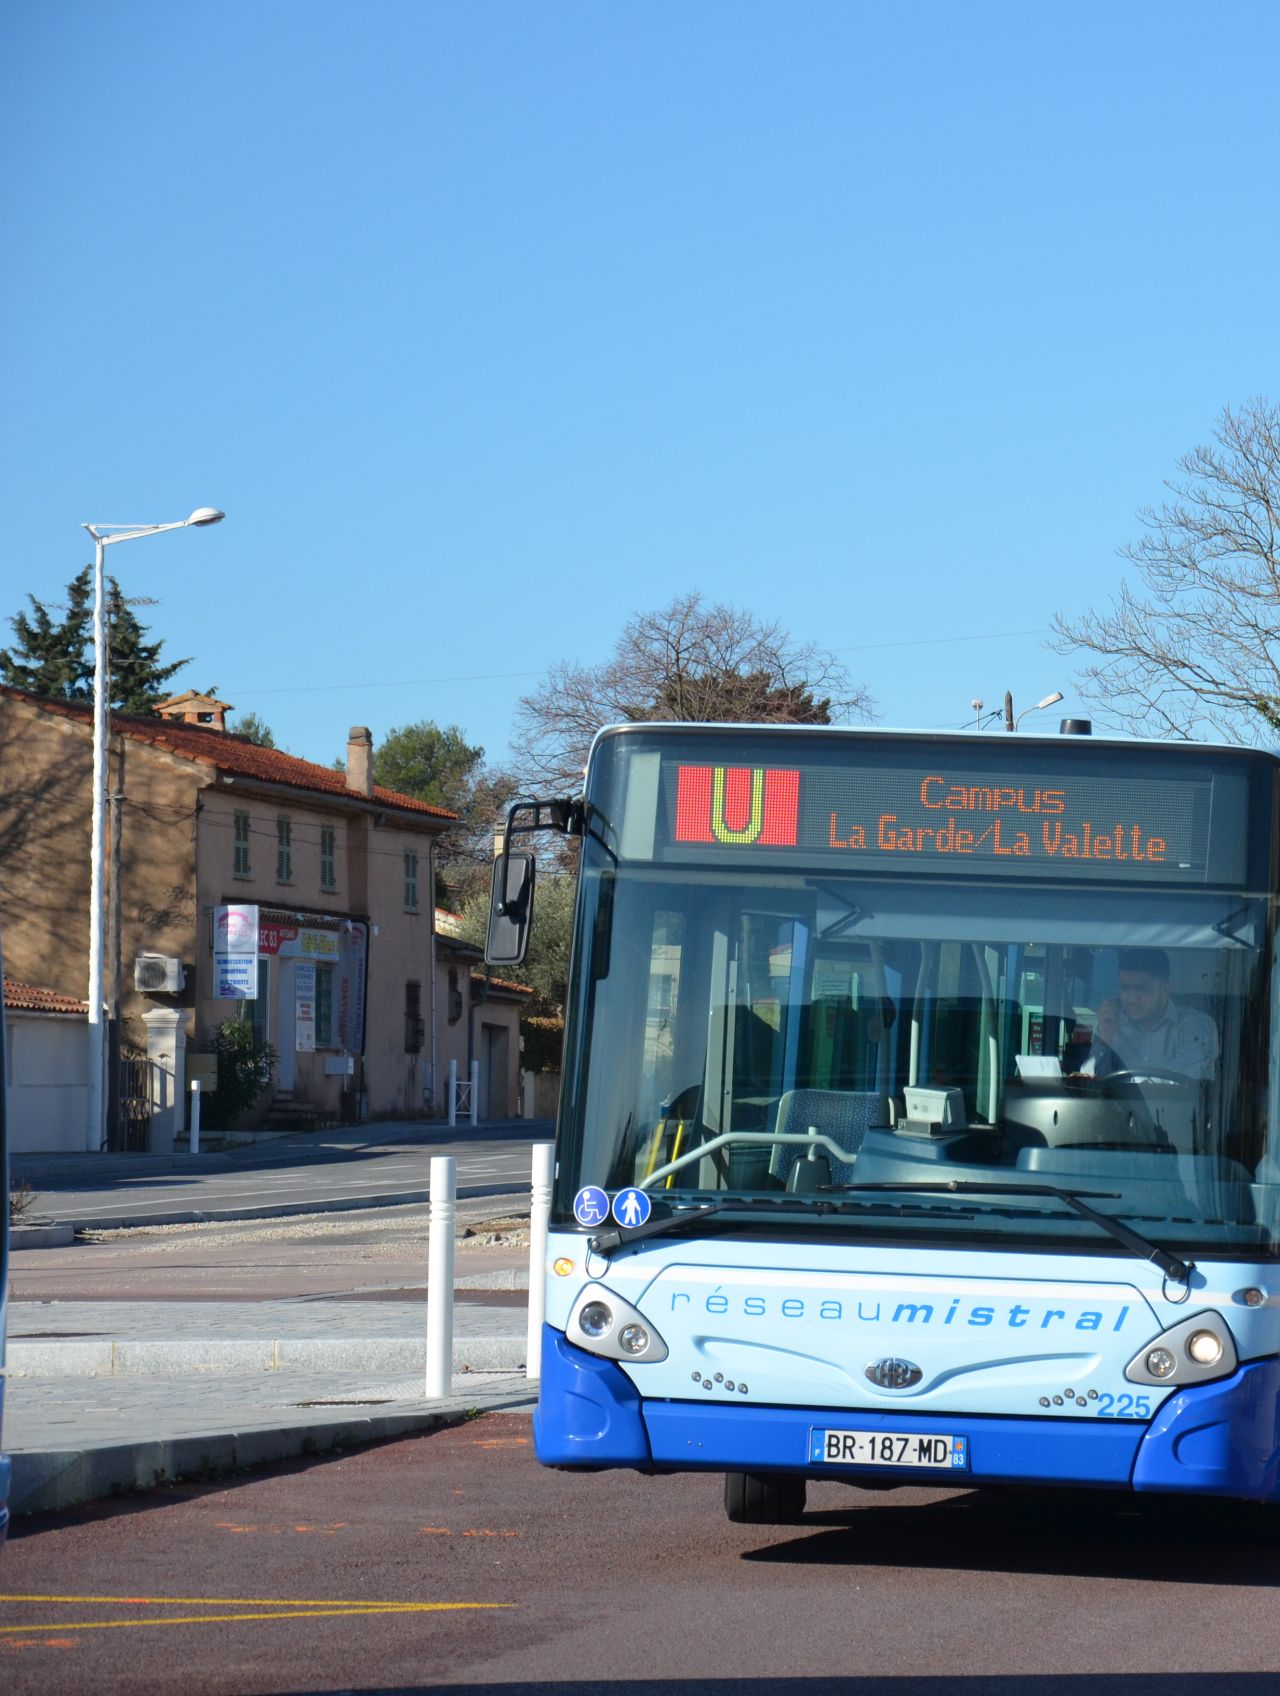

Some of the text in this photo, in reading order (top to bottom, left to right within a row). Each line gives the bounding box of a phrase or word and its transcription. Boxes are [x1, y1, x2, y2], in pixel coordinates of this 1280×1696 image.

[712, 767, 763, 844] U
[920, 776, 1066, 813] Campus
[828, 812, 866, 848] La
[1042, 821, 1166, 861] Valette
[1097, 1393, 1151, 1419] 225
[826, 1434, 948, 1463] BR-187-MD
[953, 1454, 964, 1465] 83
